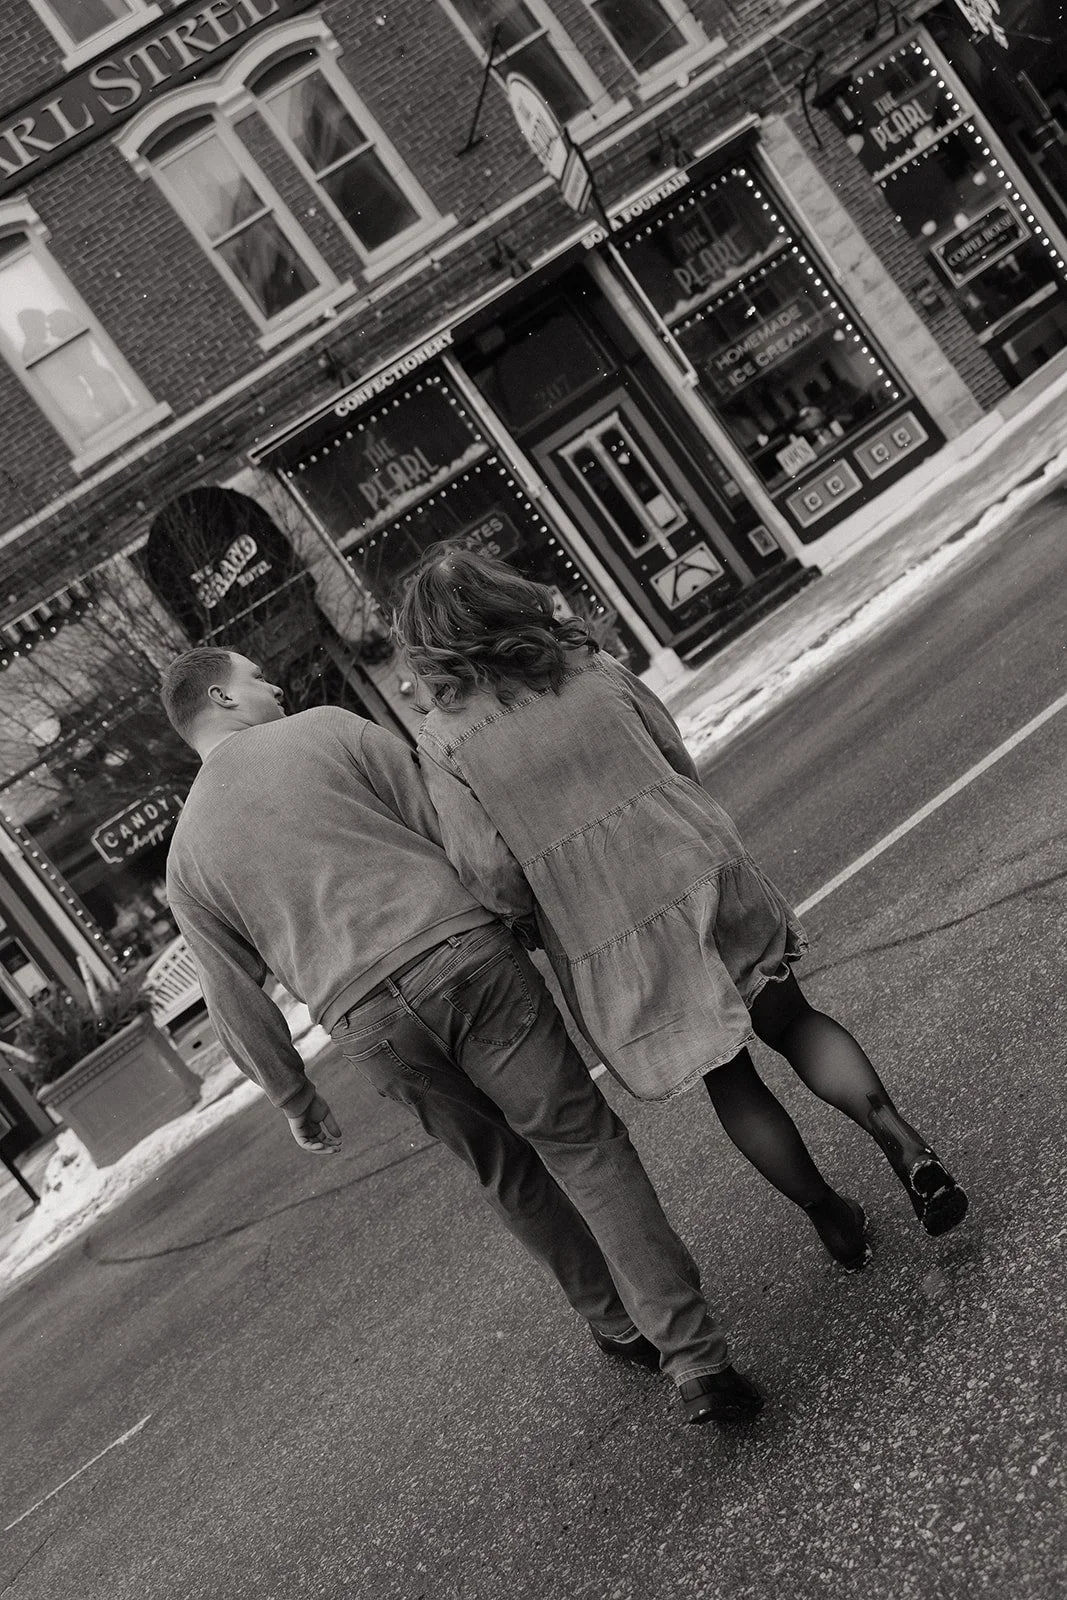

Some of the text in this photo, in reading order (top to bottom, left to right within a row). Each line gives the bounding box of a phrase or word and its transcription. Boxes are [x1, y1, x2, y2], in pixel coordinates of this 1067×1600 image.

[869, 99, 933, 151] PEARL
[872, 91, 899, 117] THE
[621, 171, 690, 223] FOUNTAIN
[674, 233, 749, 294] PEARL
[946, 235, 986, 267] COFFEE
[981, 211, 1016, 243] HOUSE
[715, 304, 802, 371] HOMEMADE
[728, 323, 811, 387] ICE CREAM
[334, 330, 454, 417] CONFECTIONERY
[358, 446, 439, 511] PEARL
[362, 437, 397, 468] THE
[198, 534, 257, 609] GRAND
[236, 560, 272, 587] HOTEL
[103, 796, 169, 848] CANDY
